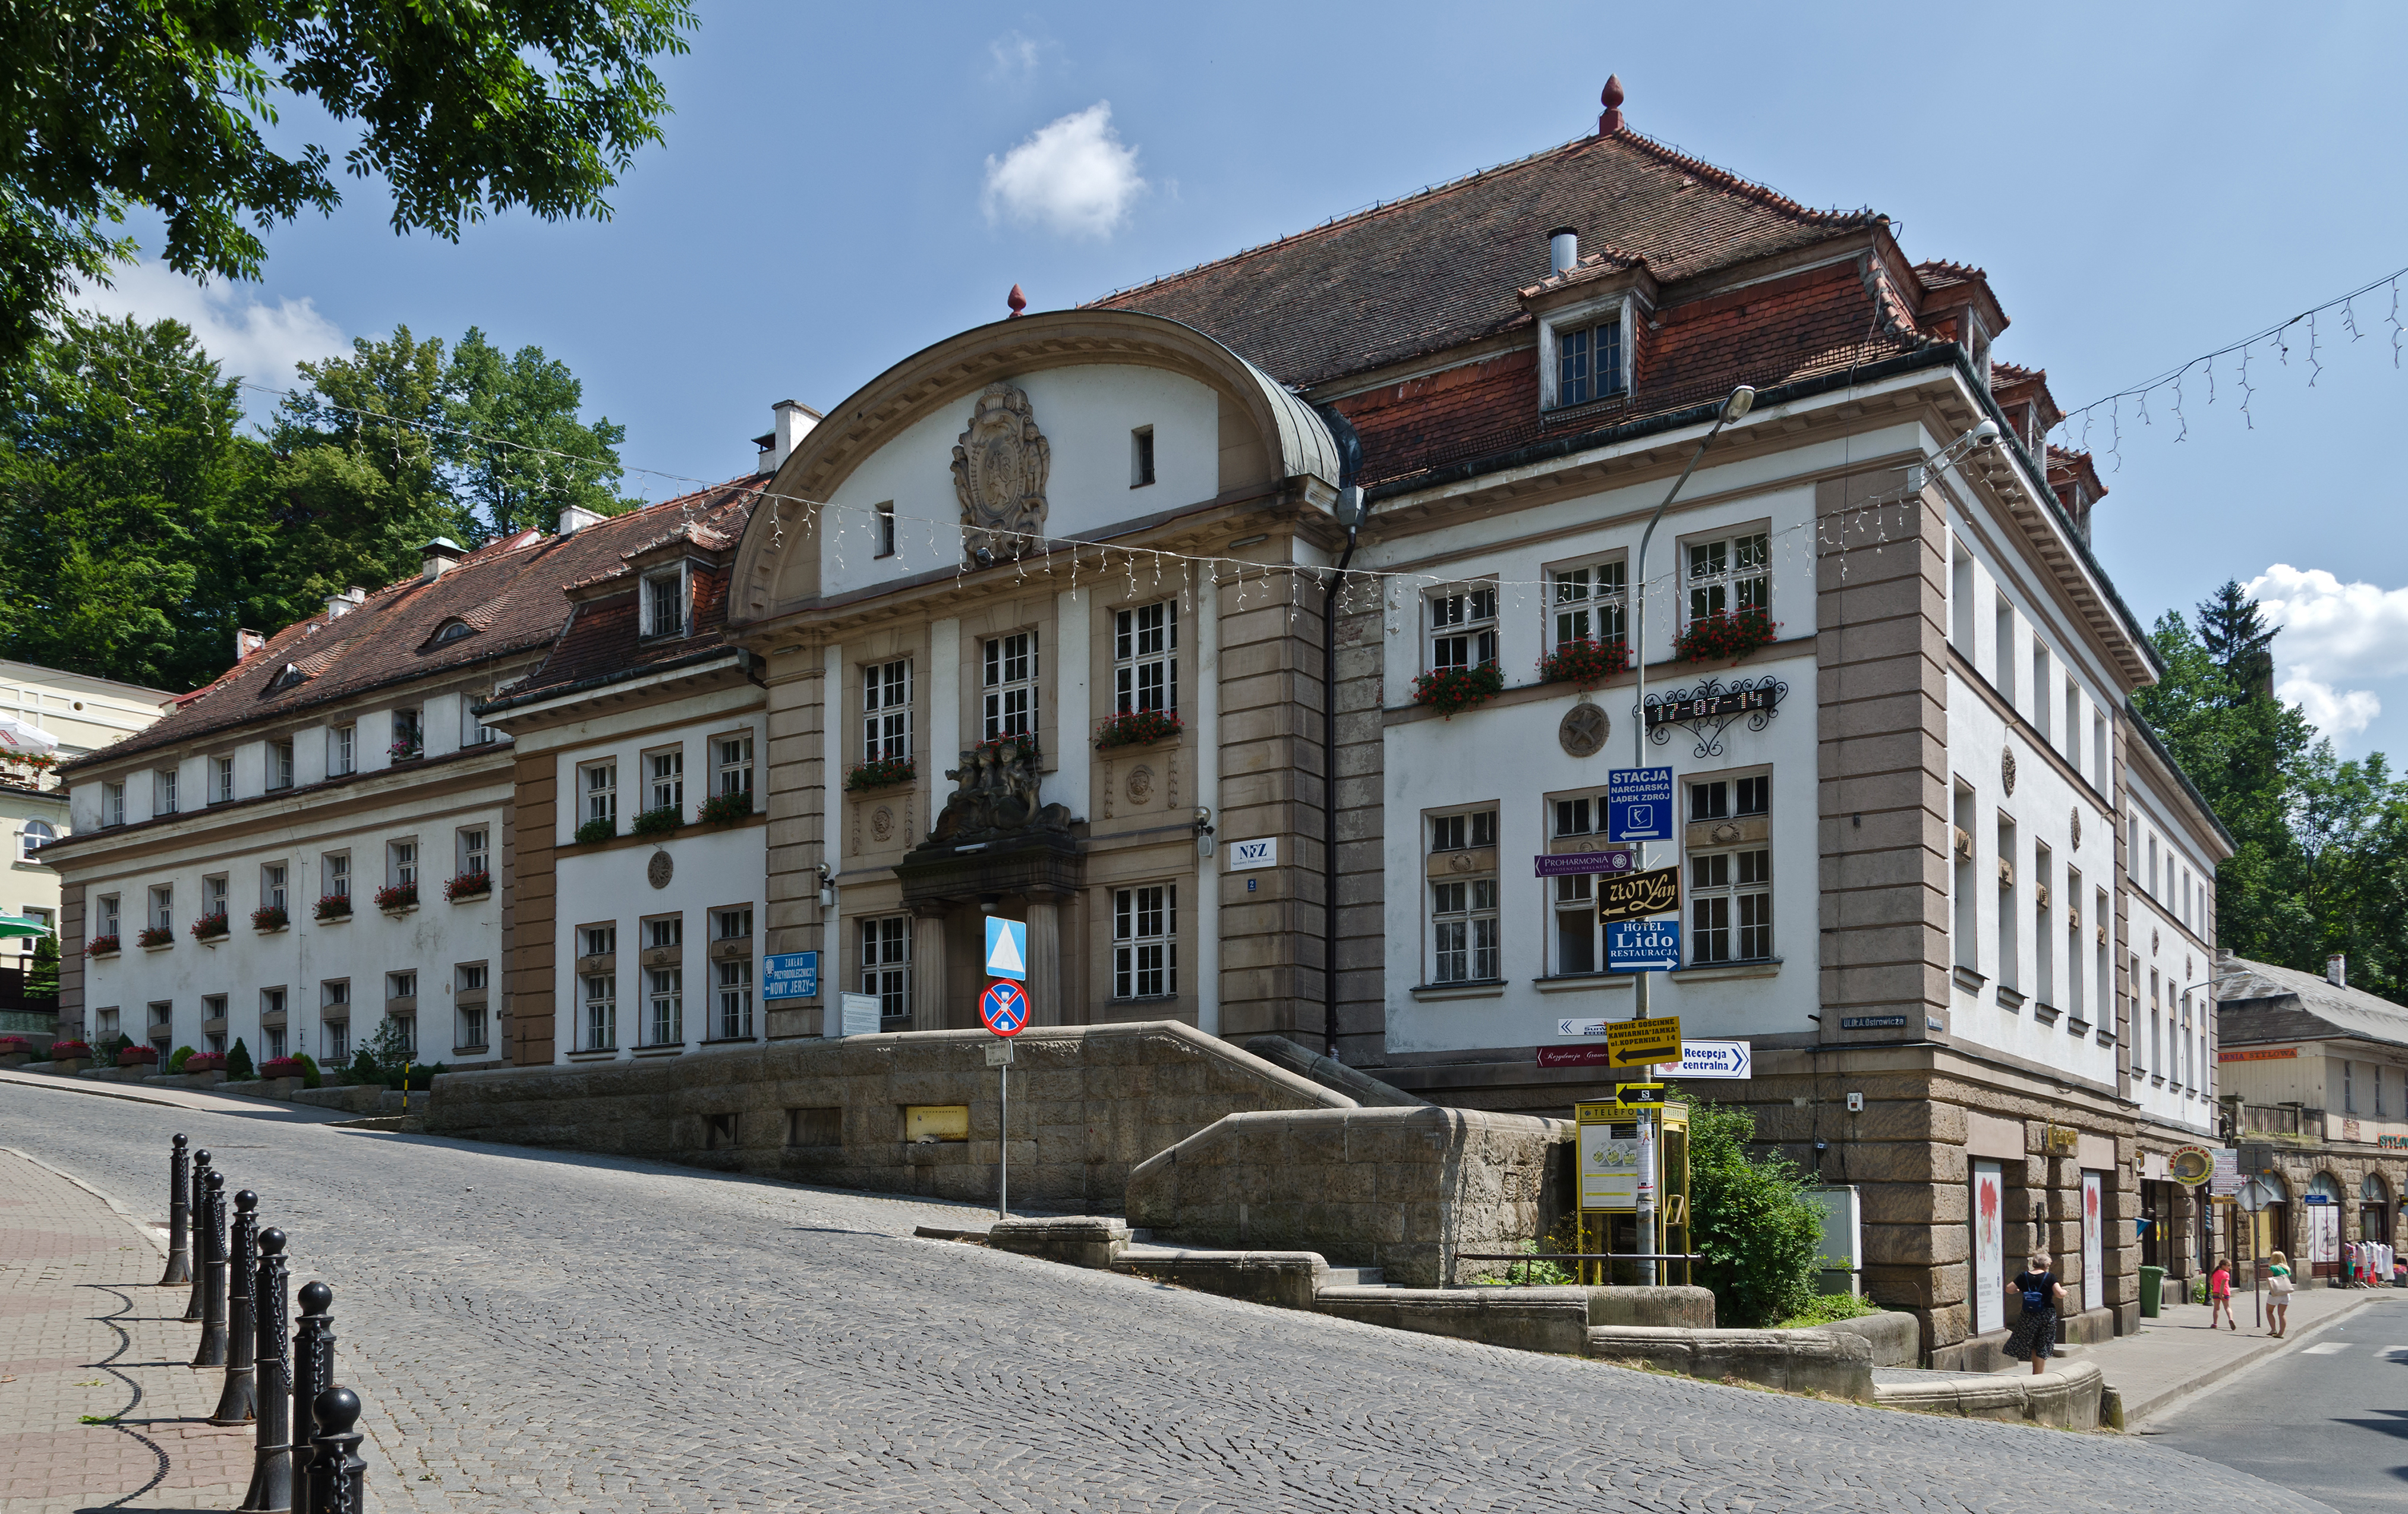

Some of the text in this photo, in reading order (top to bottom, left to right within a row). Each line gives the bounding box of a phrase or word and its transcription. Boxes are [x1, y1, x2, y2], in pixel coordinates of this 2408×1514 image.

[1655, 691, 1763, 721] 17-07-14
[1612, 770, 1669, 784] STACJA
[1611, 783, 1670, 794] NARCIARSKA
[1611, 792, 1670, 804] LĄDEK ZDRÓJ
[1240, 843, 1267, 859] NFZ
[1545, 856, 1609, 867] PROHARMONIA
[1610, 878, 1656, 901] ZŁOTY
[1624, 922, 1665, 931] HOTEL
[1615, 933, 1673, 948] Lido
[1610, 949, 1678, 957] RESTAURACJA
[785, 957, 803, 967] ZAKŁAD
[774, 968, 815, 980] PRZYRODOLECZNICZY
[770, 979, 809, 995] NOWY JERZY
[1609, 1018, 1675, 1031] POKOJE GOŚCINNE
[1609, 1030, 1650, 1039] KAWIARNIA
[1546, 1052, 1581, 1062] Rezydencja
[1684, 1049, 1726, 1059] Recepcja
[2249, 1050, 2296, 1059] STYLOWA
[1683, 1061, 1729, 1070] centralna
[1666, 1109, 1682, 1117] TELEFON
[2170, 1146, 2198, 1169] WSZYSTKO
[2199, 1150, 2209, 1158] PO
